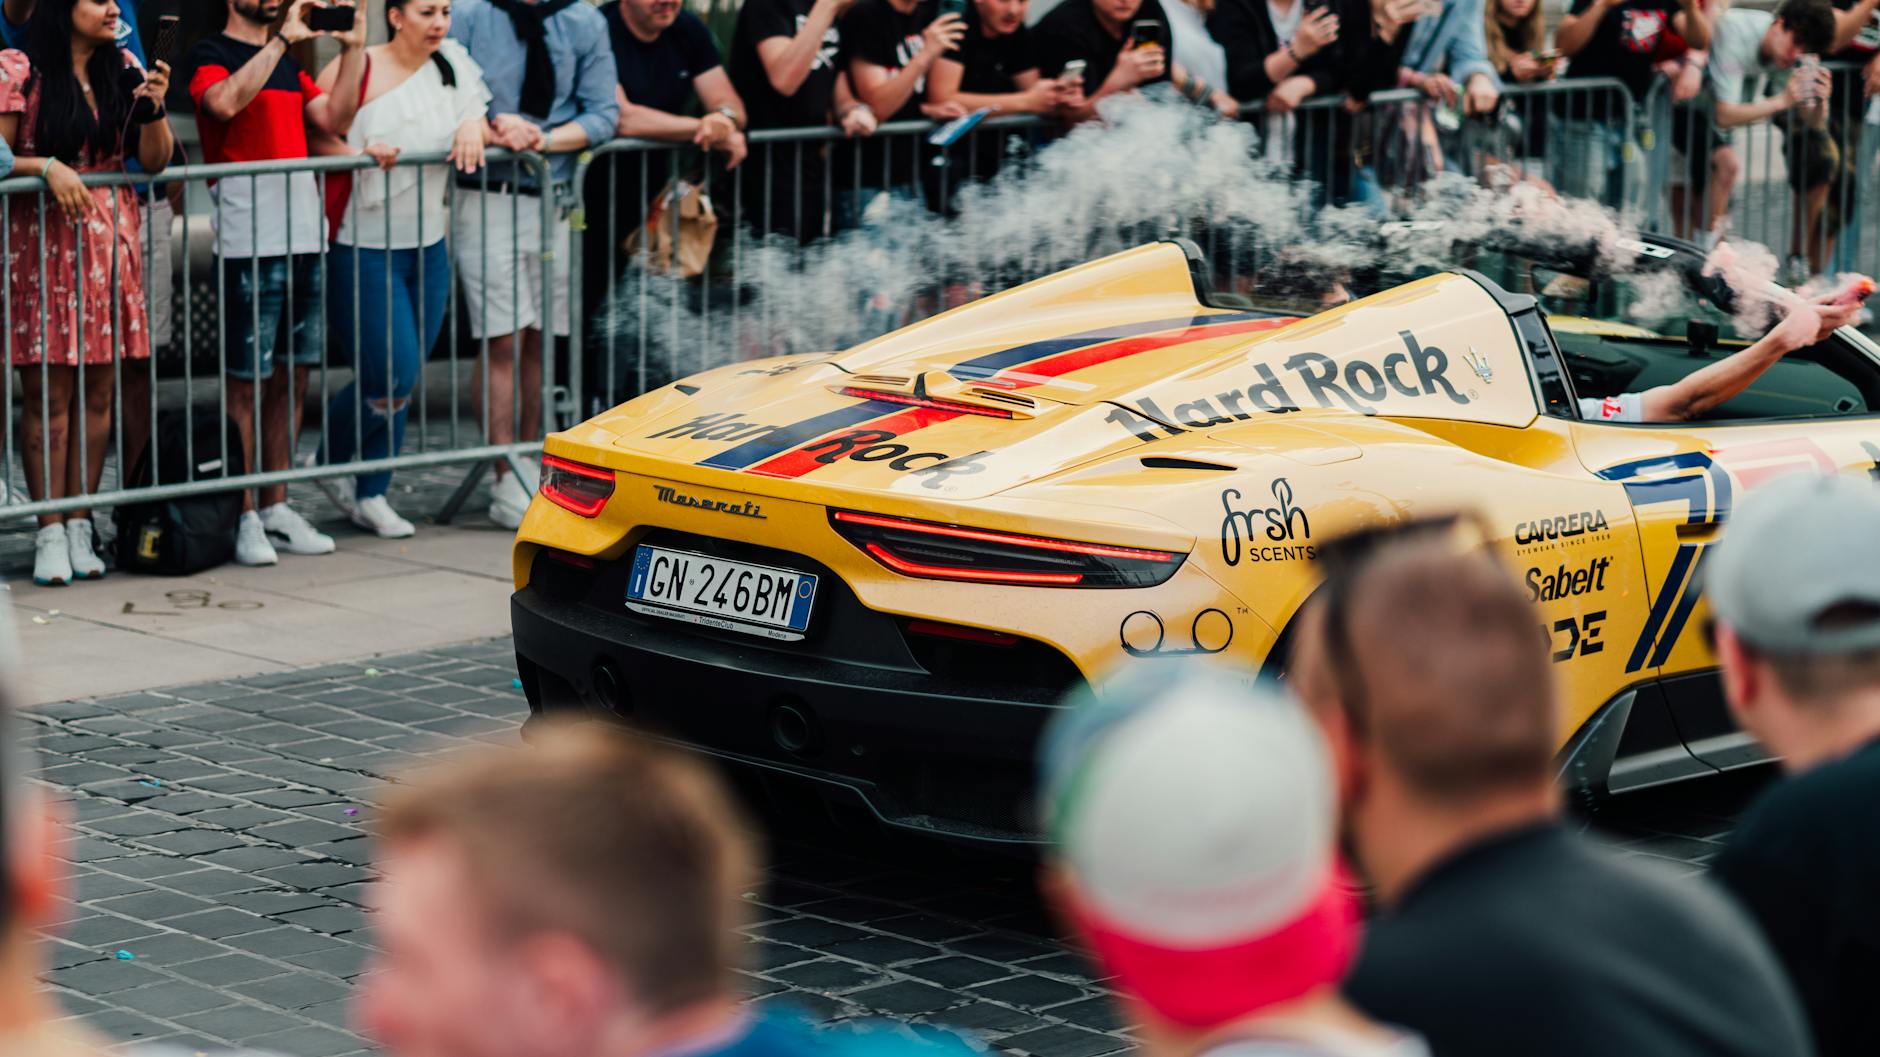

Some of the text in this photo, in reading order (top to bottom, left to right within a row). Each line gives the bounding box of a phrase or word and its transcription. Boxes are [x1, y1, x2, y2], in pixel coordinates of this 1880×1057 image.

[1105, 329, 1471, 442] Hard Rock
[802, 429, 988, 490] Rock
[653, 484, 768, 520] Maserati
[1222, 477, 1310, 567] frsh
[1514, 509, 1609, 545] CARRERA
[1516, 543, 1555, 557] EYEWEAR
[1561, 538, 1585, 548] SINCE
[1250, 545, 1317, 562] SCENTS
[649, 556, 794, 621] GN 246BM
[1525, 556, 1610, 602] Sabelt
[767, 630, 787, 639] Modena
